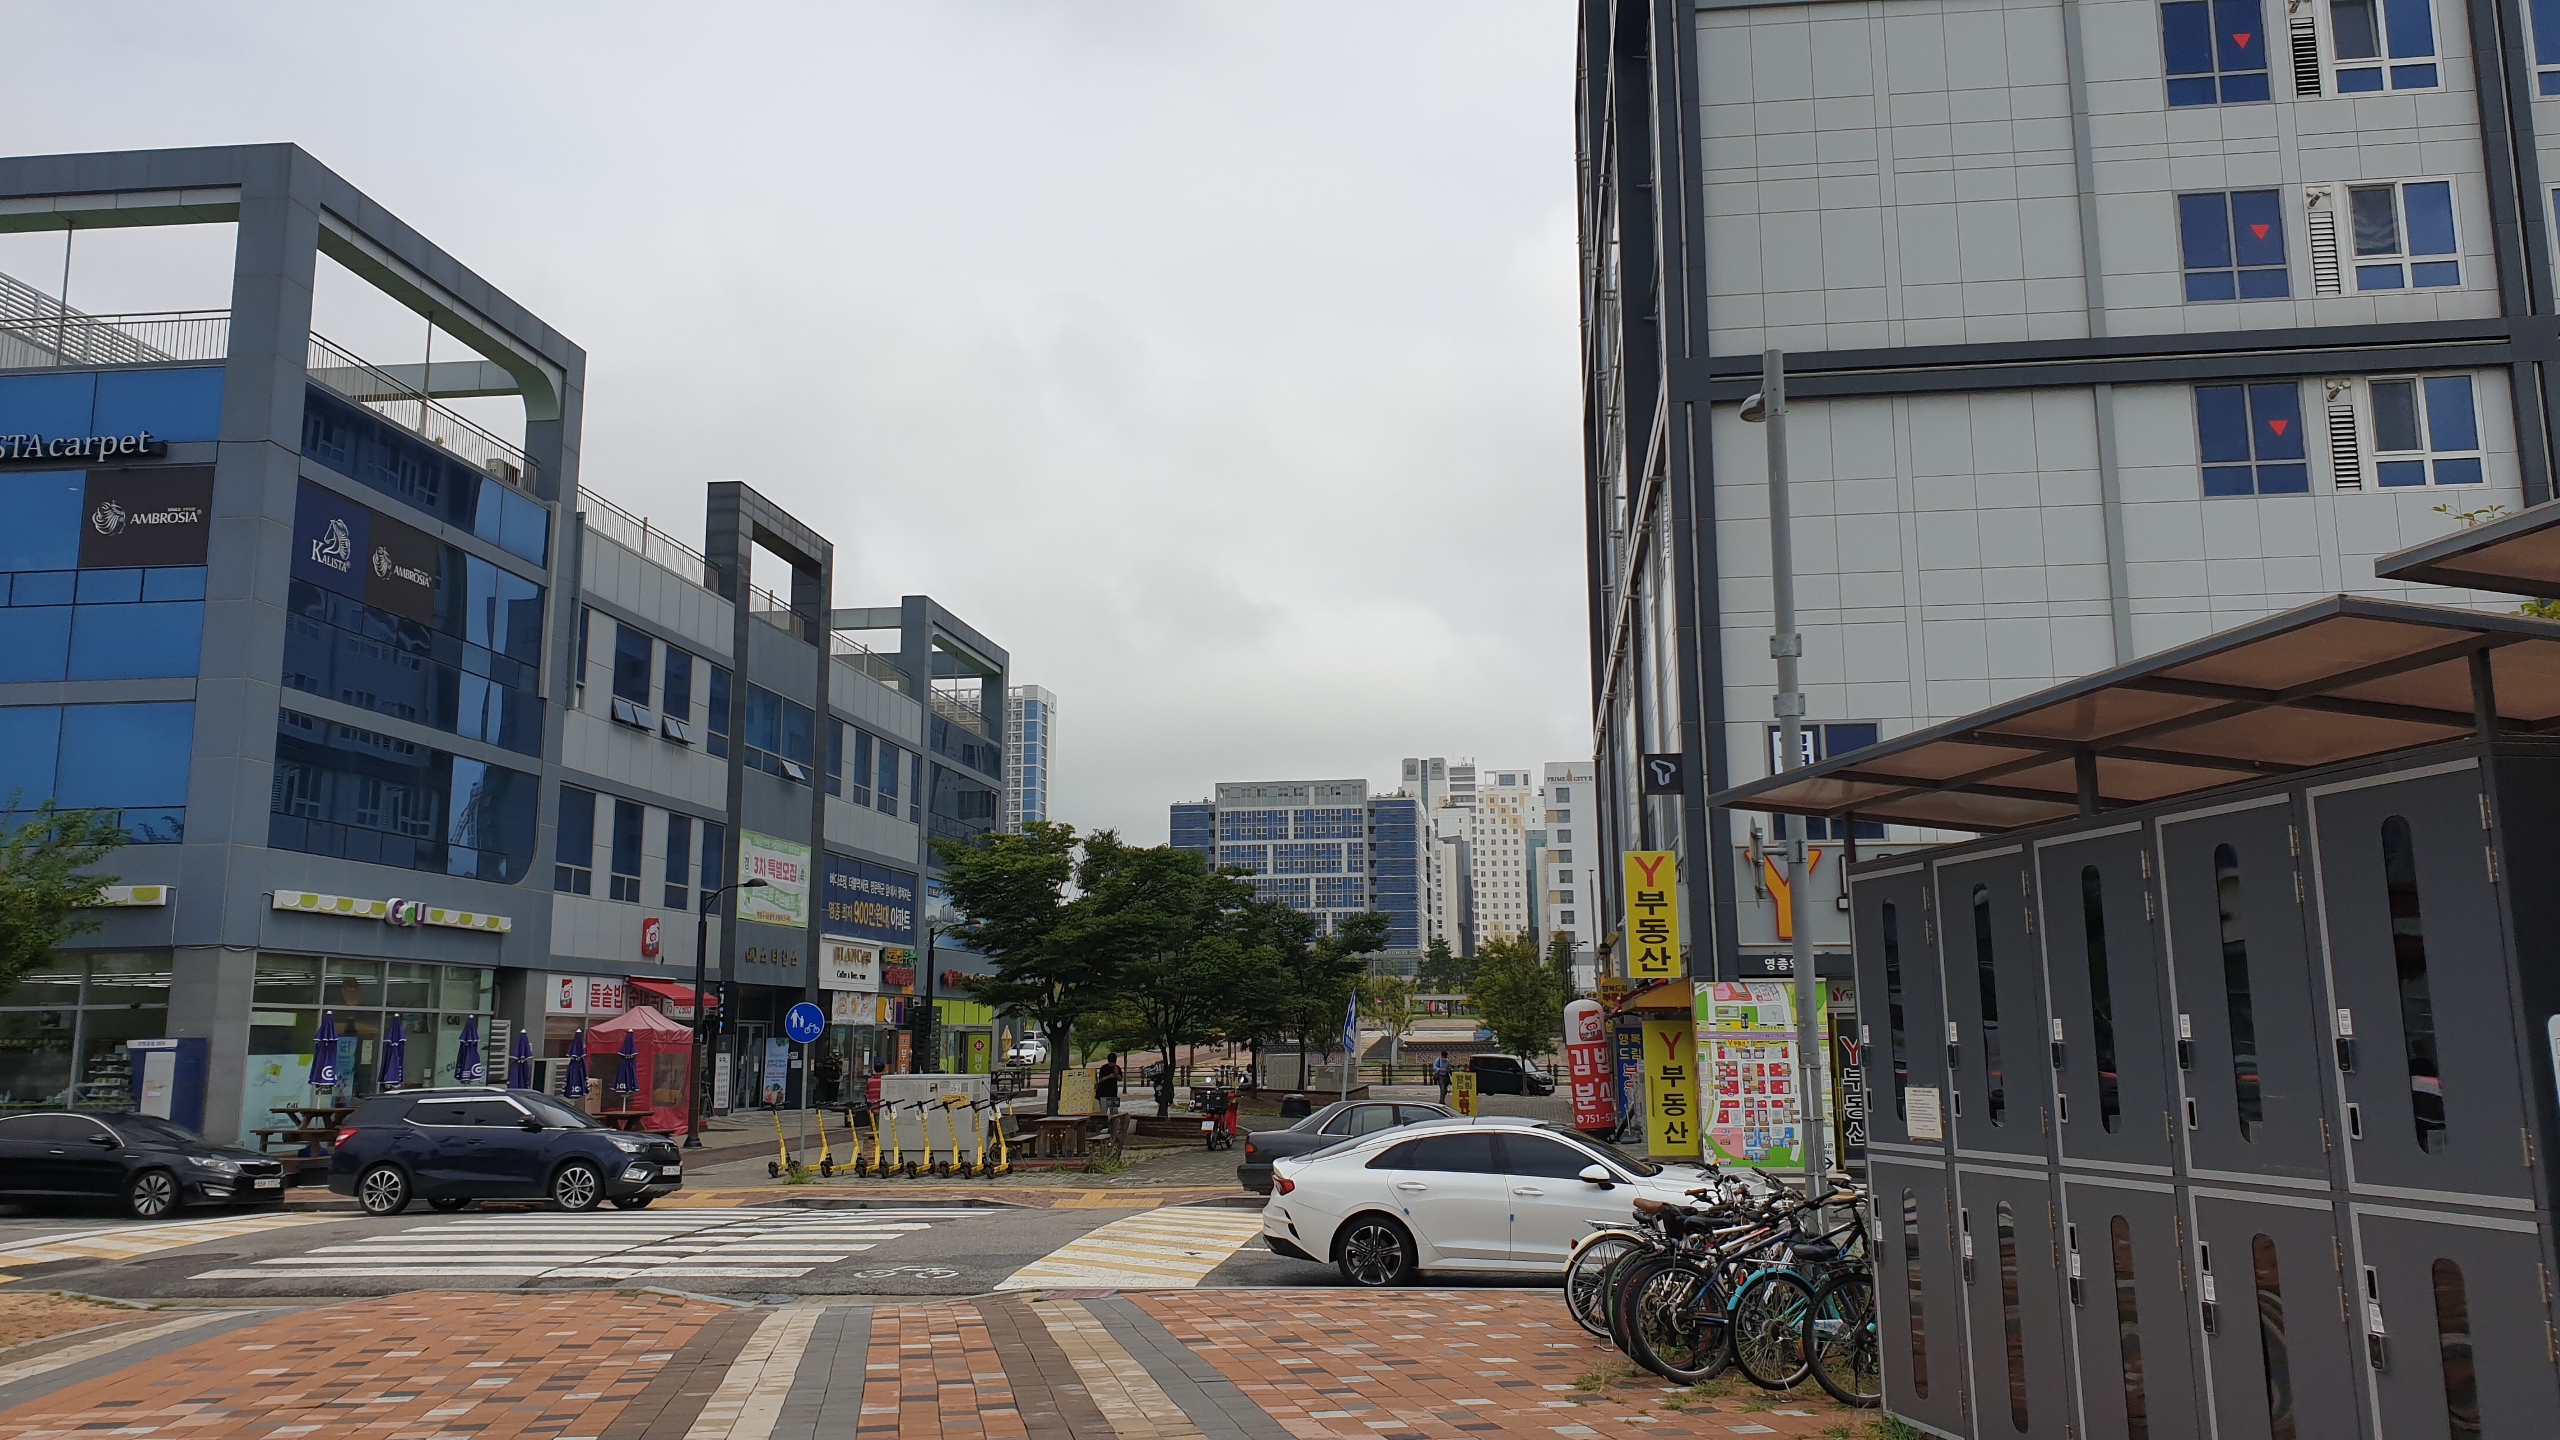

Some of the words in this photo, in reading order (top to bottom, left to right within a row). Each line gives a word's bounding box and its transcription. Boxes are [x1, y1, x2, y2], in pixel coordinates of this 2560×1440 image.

[49, 430, 151, 463] carpet
[130, 511, 198, 524] AMBROSIA
[311, 539, 347, 573] KALISTA
[393, 565, 430, 588] AMBROSIA
[767, 858, 797, 883] 특별모집
[828, 901, 841, 921] 영종
[853, 900, 890, 929] 900만원대
[890, 906, 911, 932] 아파트
[590, 983, 625, 1009] 돌솥밥
[1571, 1048, 1612, 1077] 김밥
